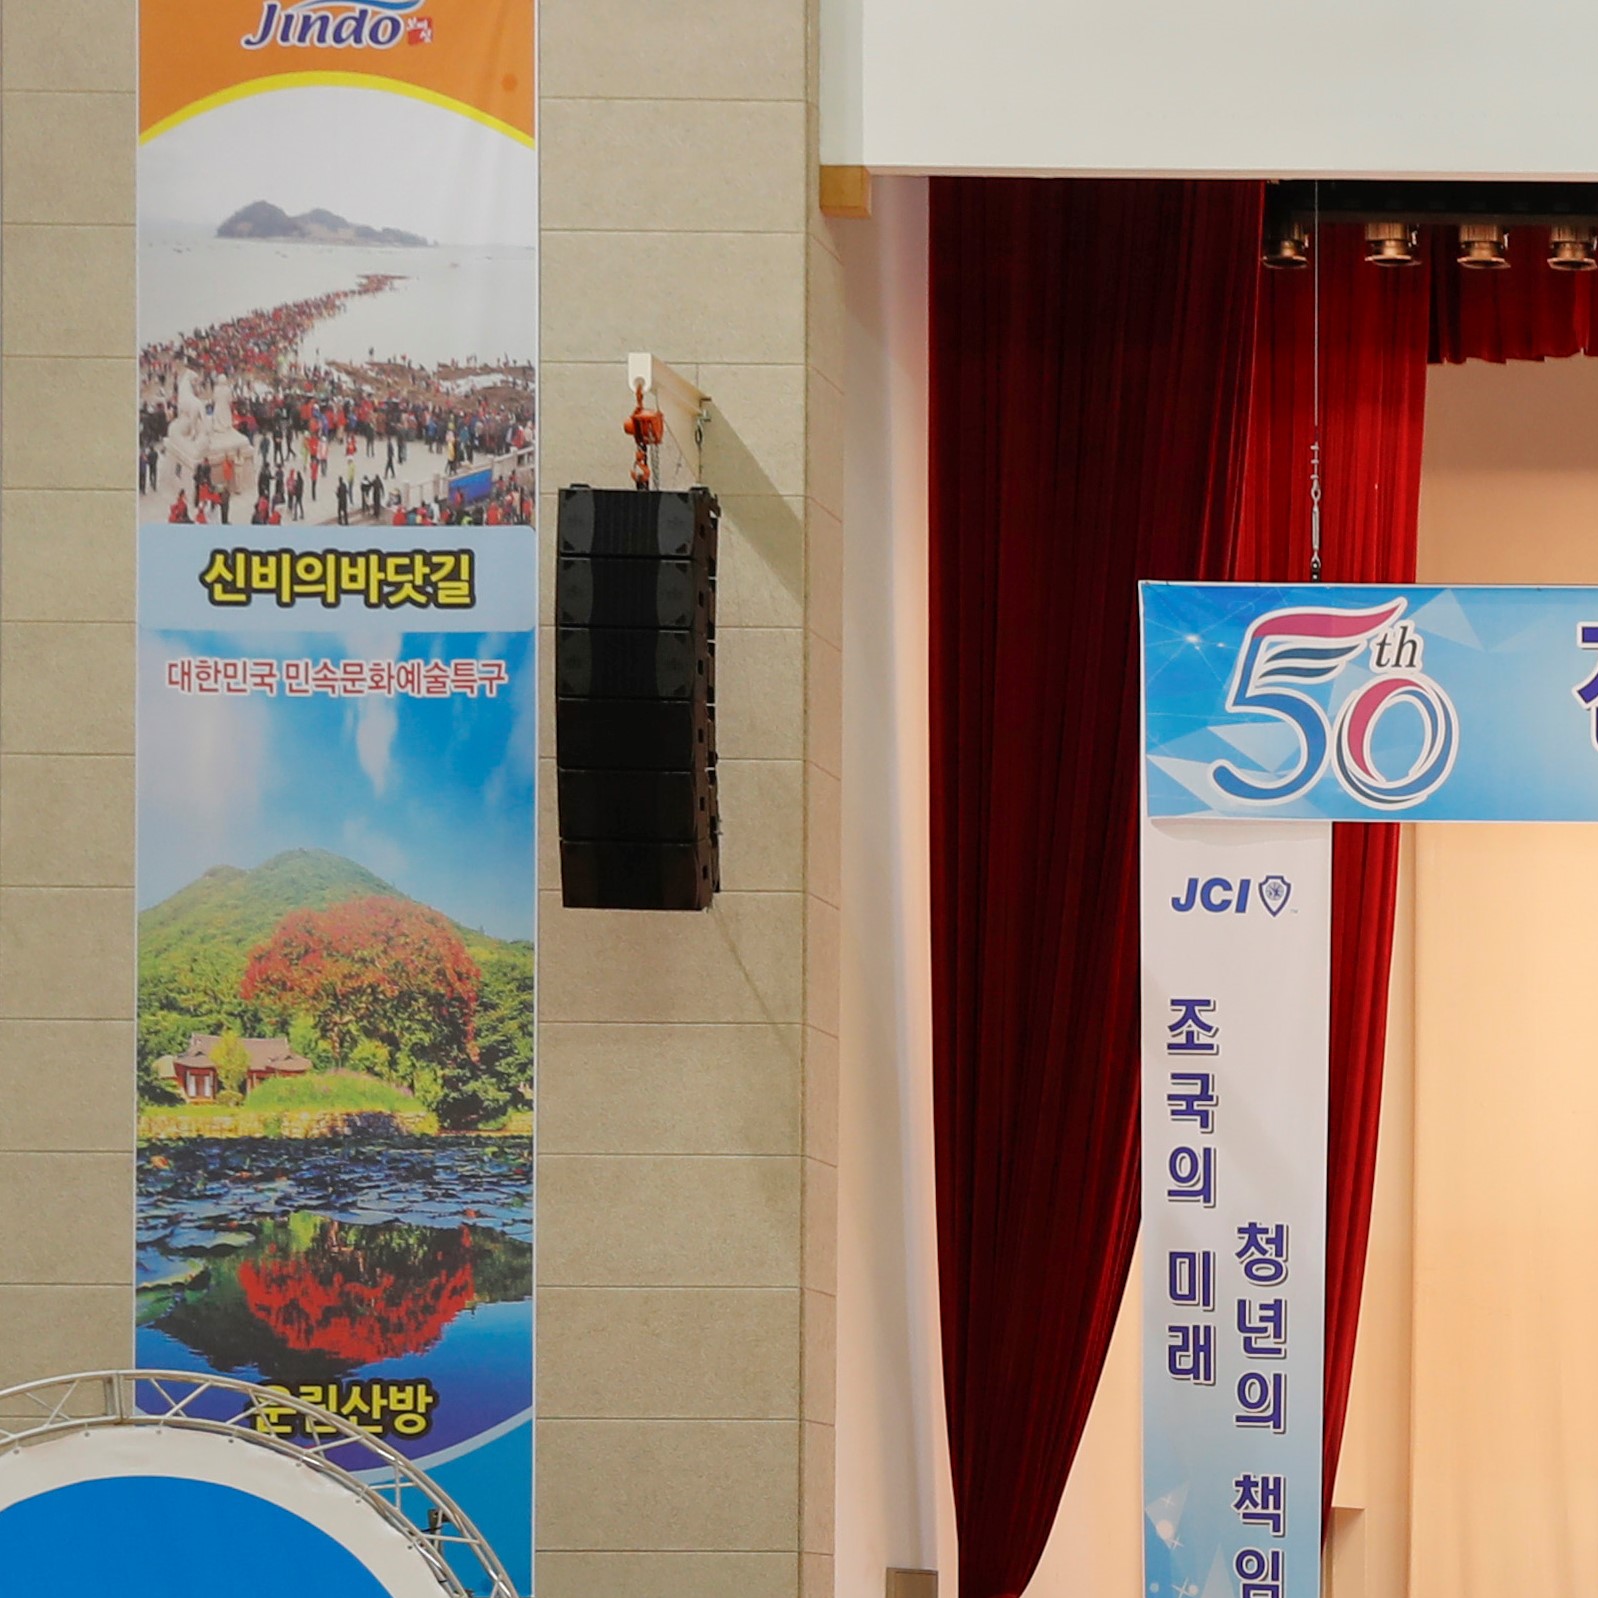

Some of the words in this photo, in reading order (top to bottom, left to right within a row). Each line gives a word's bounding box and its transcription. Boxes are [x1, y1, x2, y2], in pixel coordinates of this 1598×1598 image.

[242, 2, 403, 48] Jindo
[202, 551, 474, 605] 신비의바닷길
[167, 659, 277, 694] 대한민국
[284, 659, 506, 695] 민속문화예술특구
[1171, 877, 1251, 913] JCI
[1167, 999, 1217, 1206] 조국의
[1167, 1250, 1216, 1385] 미래
[1235, 1222, 1288, 1434] 청년의
